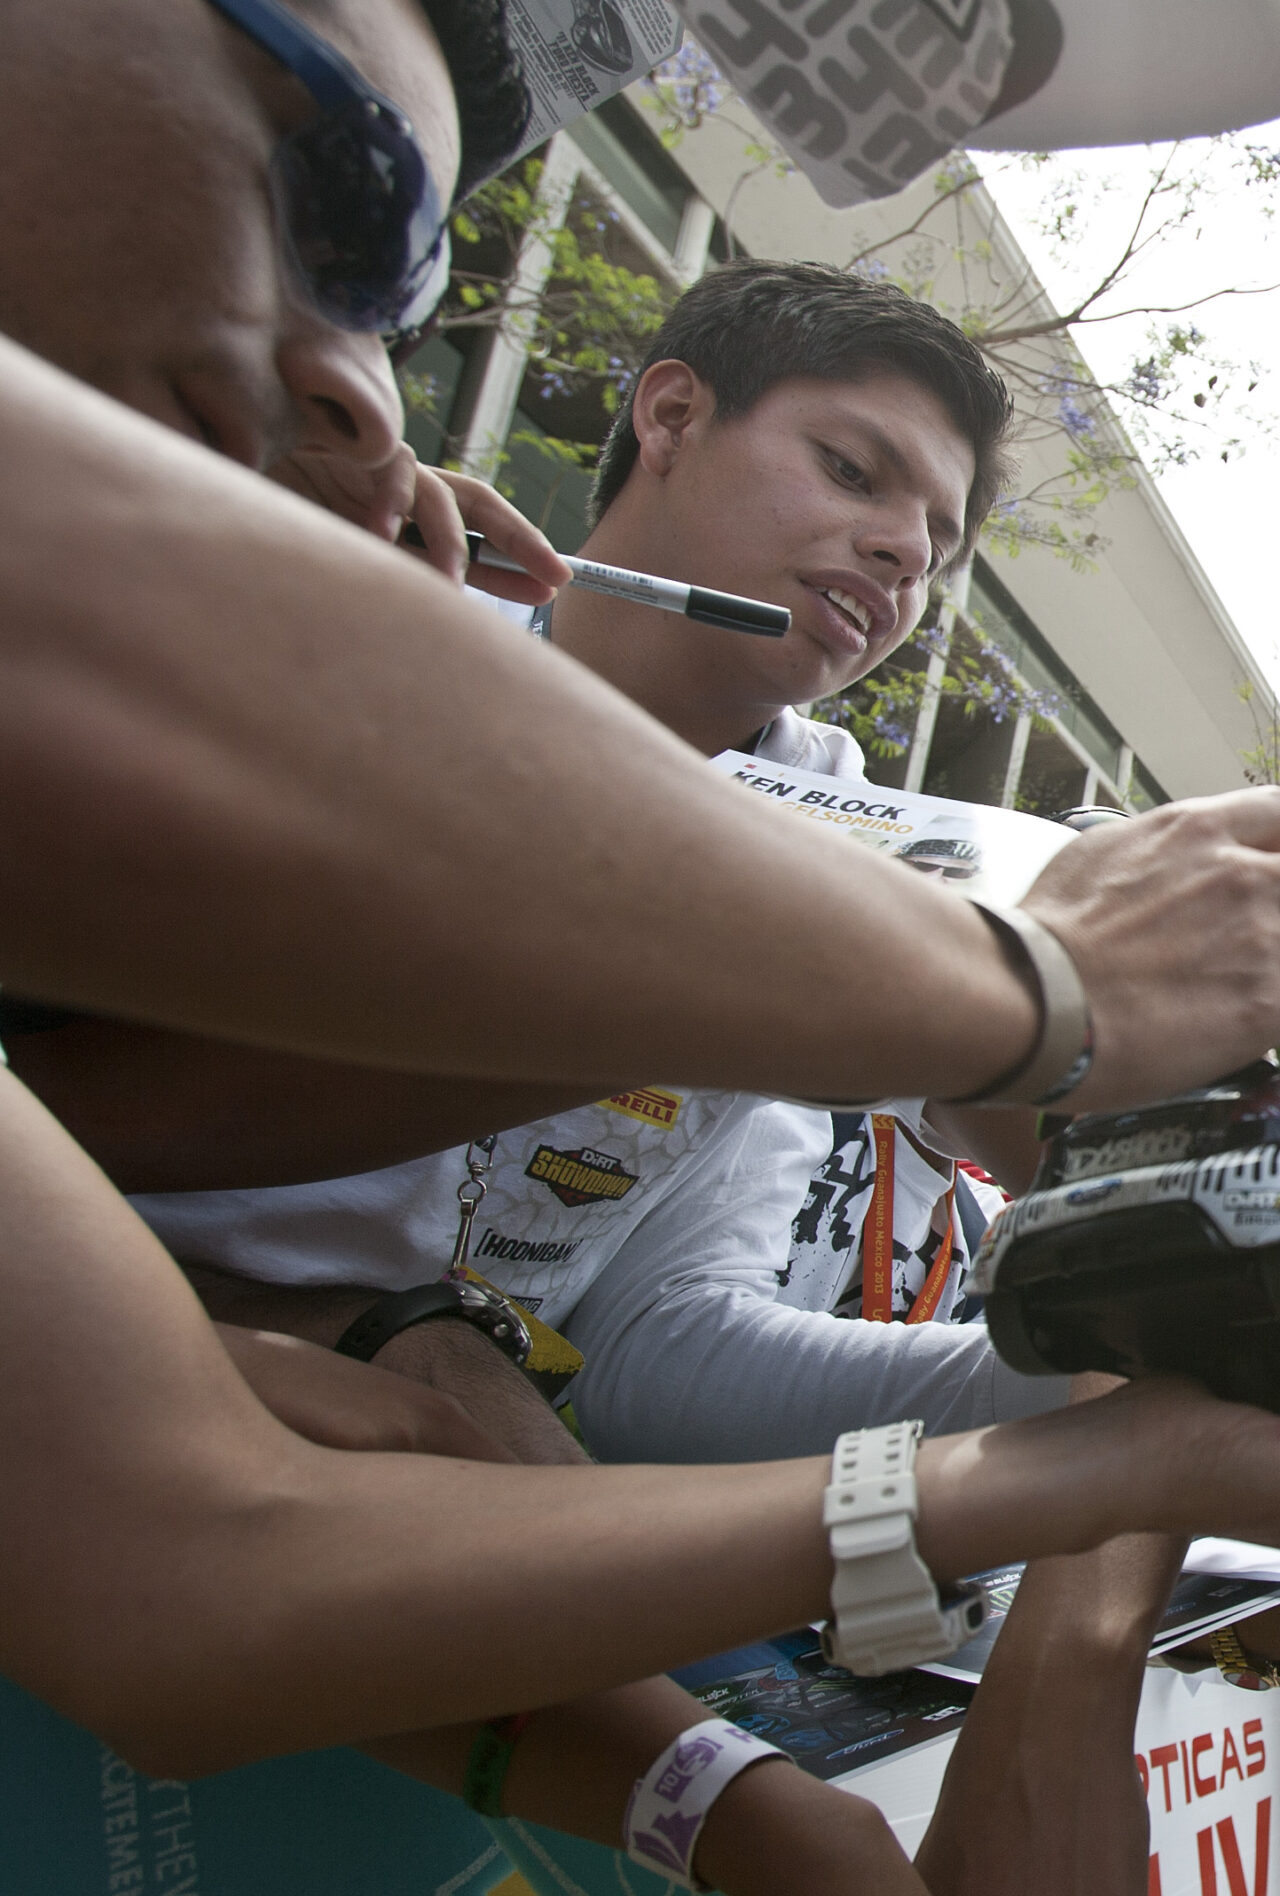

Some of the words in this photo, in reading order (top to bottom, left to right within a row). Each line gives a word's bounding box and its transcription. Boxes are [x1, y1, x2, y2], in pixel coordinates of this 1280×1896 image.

[564, 67, 591, 102] FIESTA
[573, 62, 600, 97] BLOCK
[731, 770, 796, 797] KEN
[799, 788, 906, 821] BLOCK
[877, 1141, 887, 1166] Rally
[531, 1150, 634, 1198] SHOWDOWN
[875, 1169, 887, 1227] Guanajuato
[874, 1271, 884, 1293] 2013
